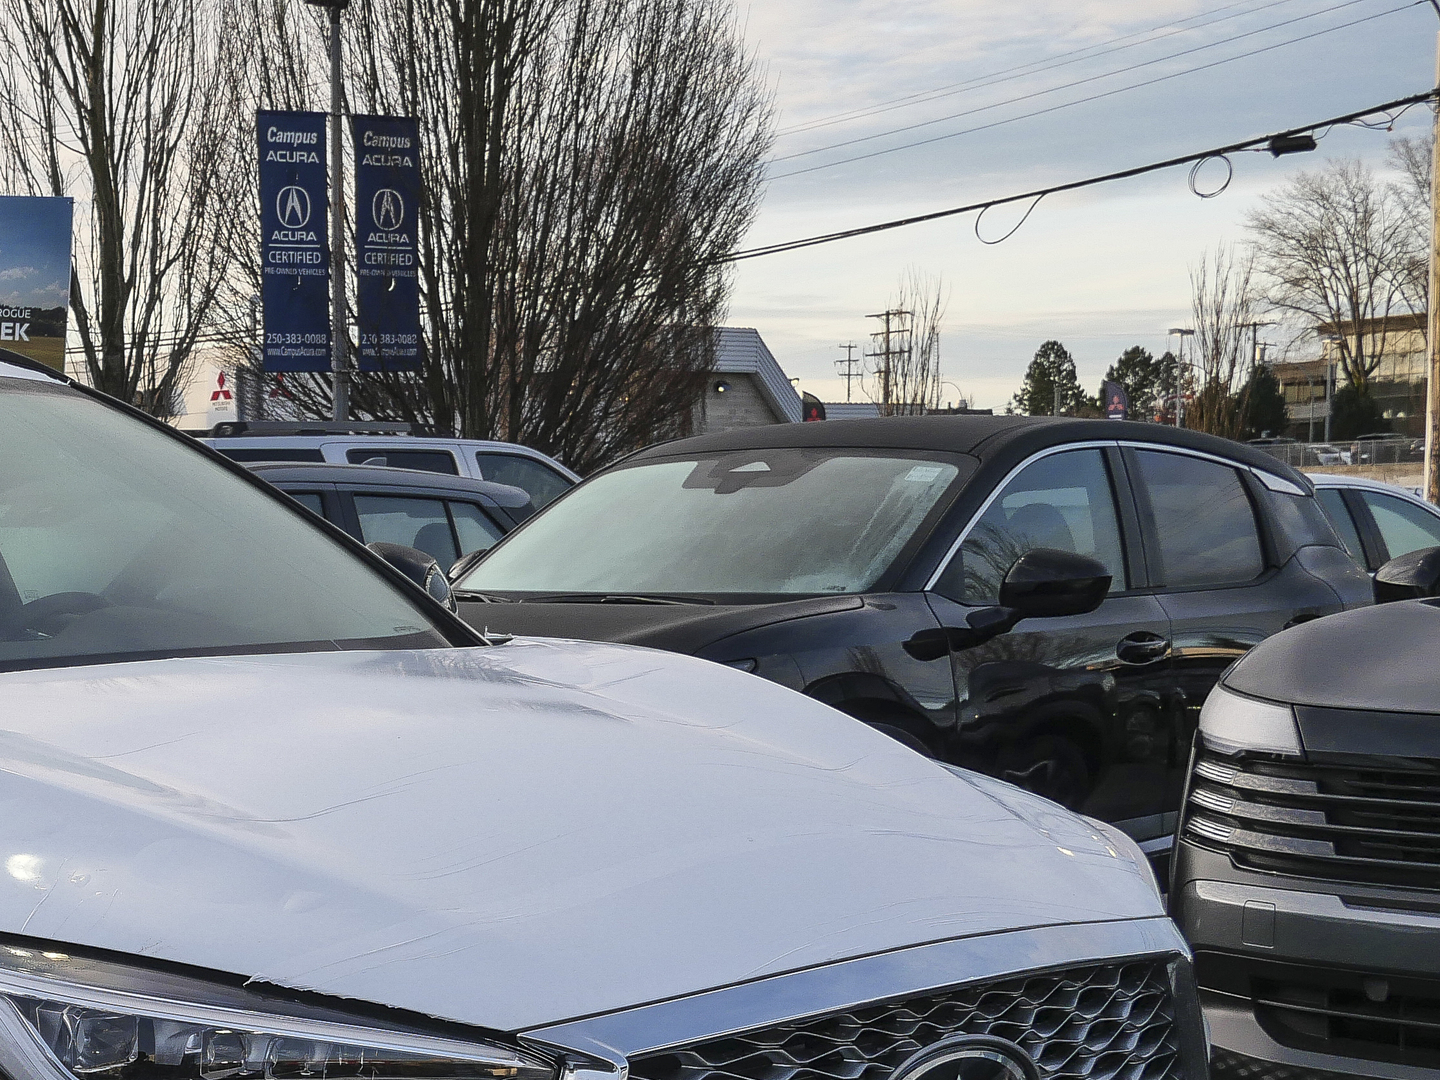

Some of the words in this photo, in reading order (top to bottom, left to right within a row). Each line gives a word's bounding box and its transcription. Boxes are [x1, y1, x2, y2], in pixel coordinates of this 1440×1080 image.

[267, 126, 318, 147] Campus
[363, 131, 411, 150] Campus
[266, 151, 319, 164] ACURA
[362, 154, 413, 167] ACURA
[272, 231, 317, 241] ACURA
[367, 233, 409, 243] ACURA
[268, 251, 321, 264] CERTIFIED
[267, 333, 327, 344] 250-383-0088
